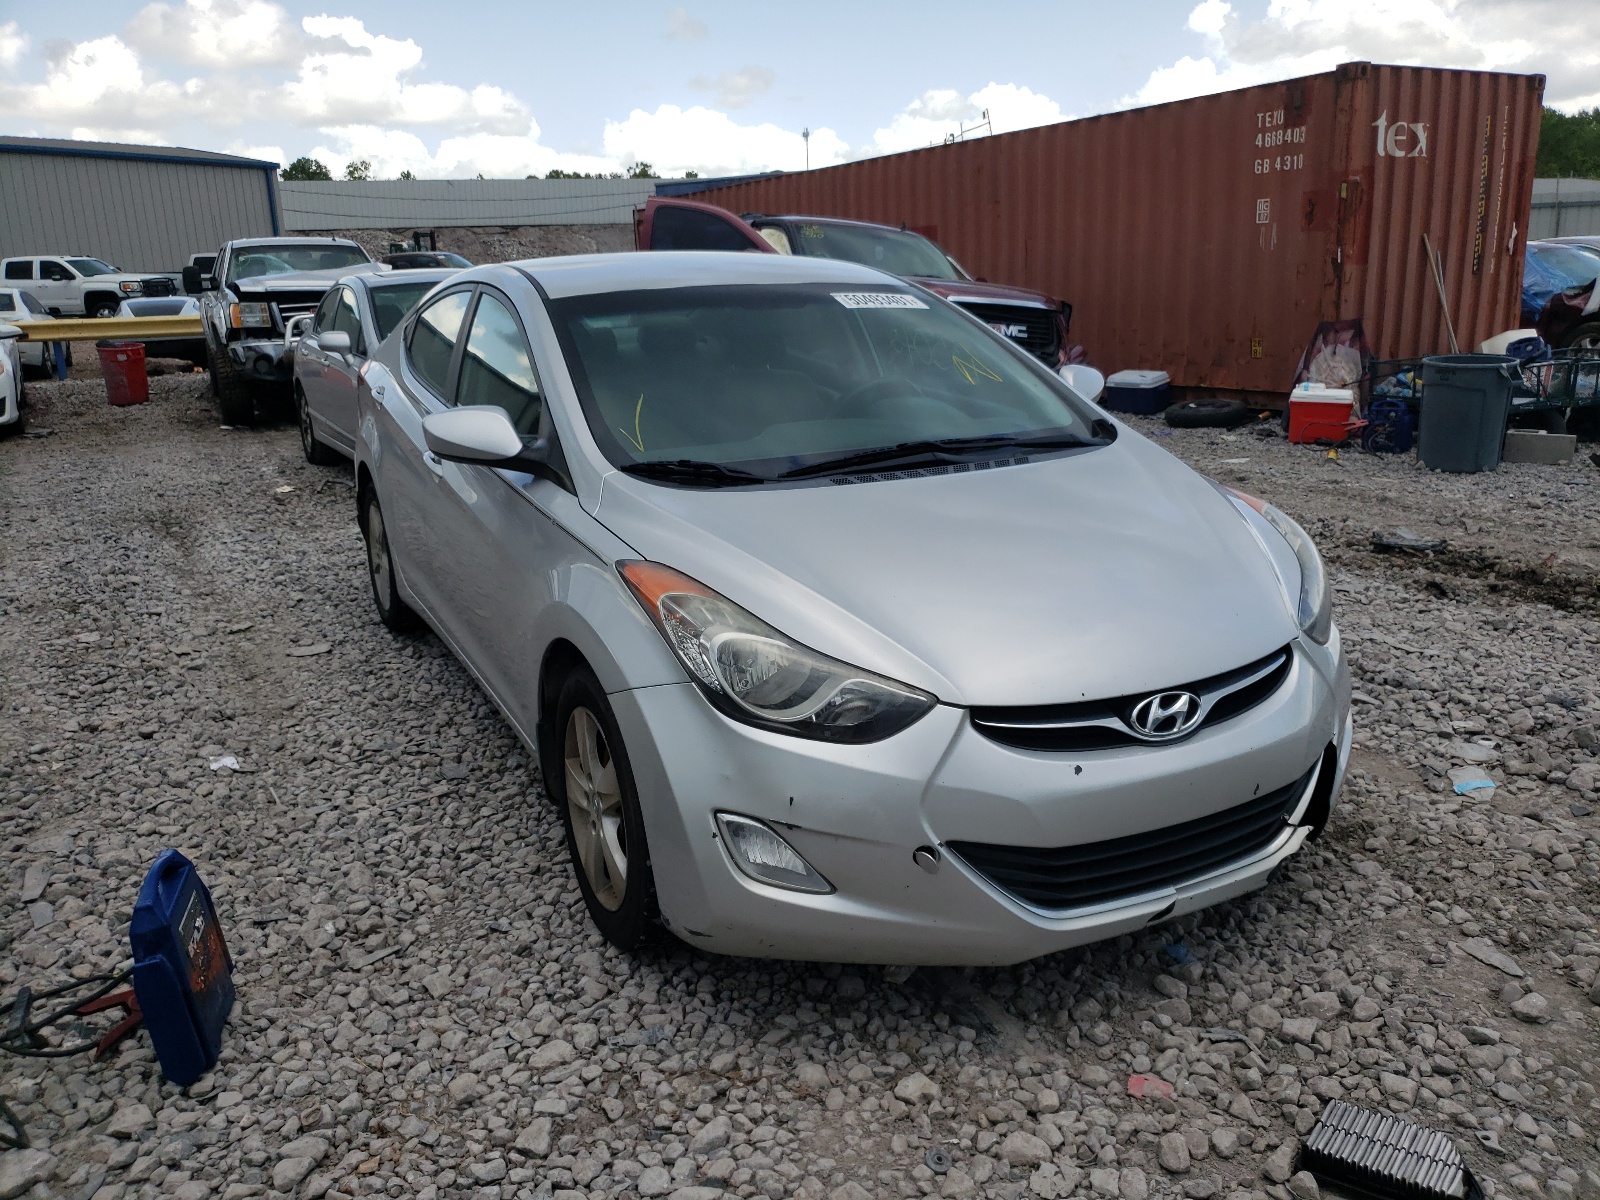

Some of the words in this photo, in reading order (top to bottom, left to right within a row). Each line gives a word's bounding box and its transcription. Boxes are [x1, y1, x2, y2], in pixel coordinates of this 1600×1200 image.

[1257, 109, 1284, 128] TEXU
[1255, 126, 1306, 148] 4668403
[1371, 109, 1430, 157] tex
[1254, 158, 1270, 174] GB
[1275, 153, 1303, 171] 4310
[843, 294, 912, 305] 50493401
